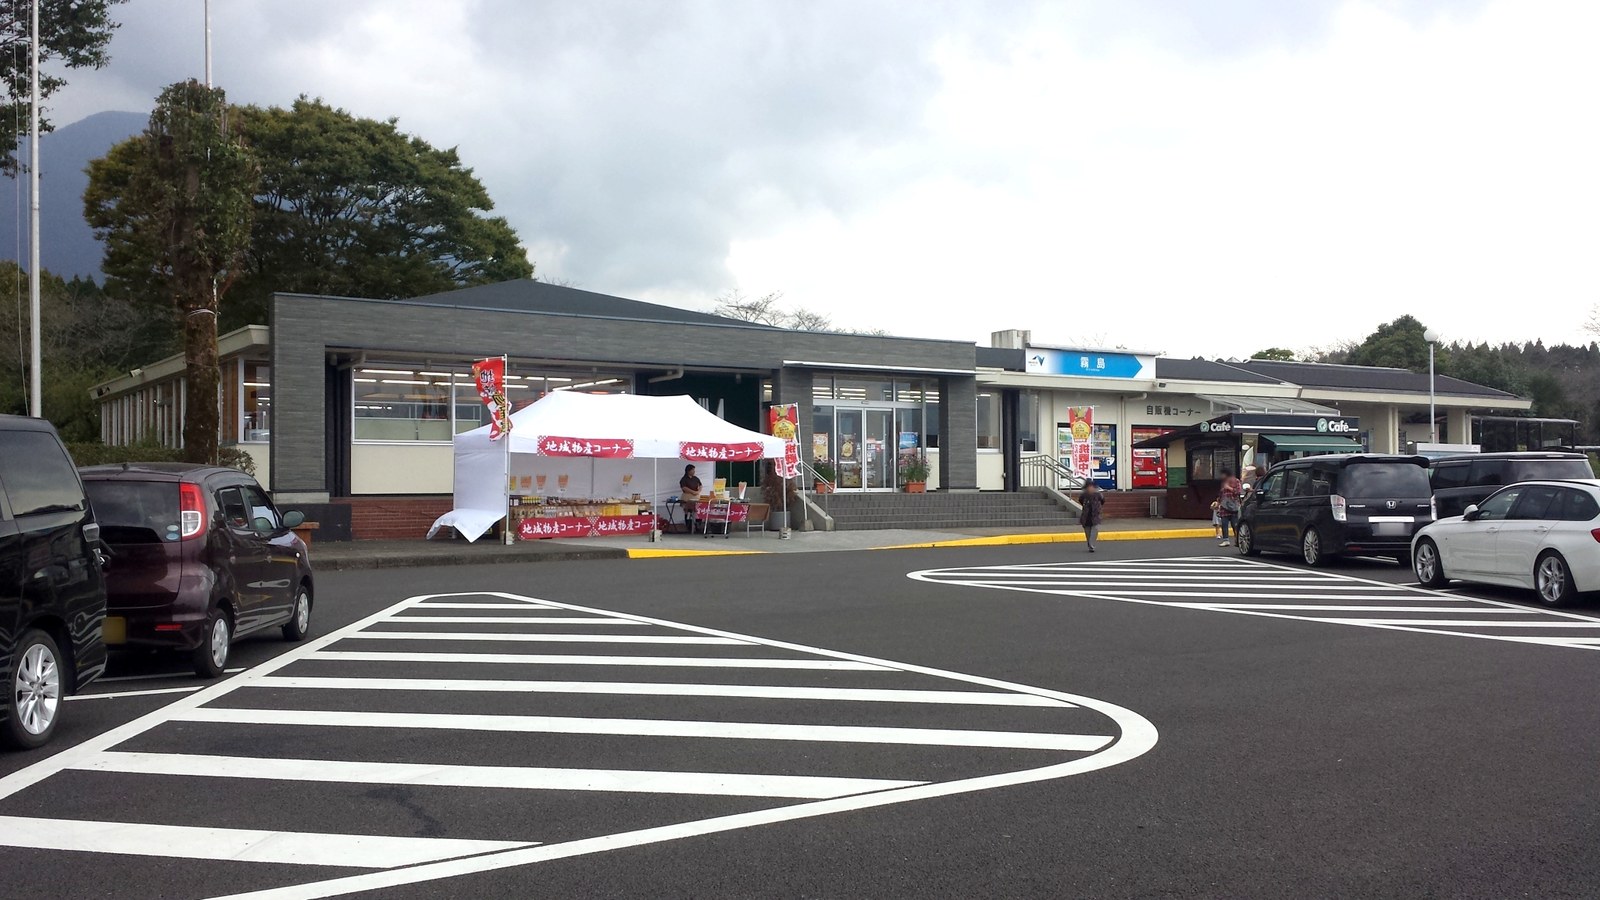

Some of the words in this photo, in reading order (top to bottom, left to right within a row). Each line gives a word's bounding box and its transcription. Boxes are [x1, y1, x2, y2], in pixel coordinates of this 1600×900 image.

[1080, 356, 1105, 370] 霧島
[1146, 405, 1201, 416] 自販機コーナー
[1210, 421, 1231, 432] Café
[1328, 420, 1349, 432] Café
[545, 440, 631, 454] 地域物産コーナー
[686, 446, 760, 459] 地域物産コーナー
[522, 522, 591, 534] 地域物産コーナー
[598, 518, 659, 531] 地域物産コーナ
